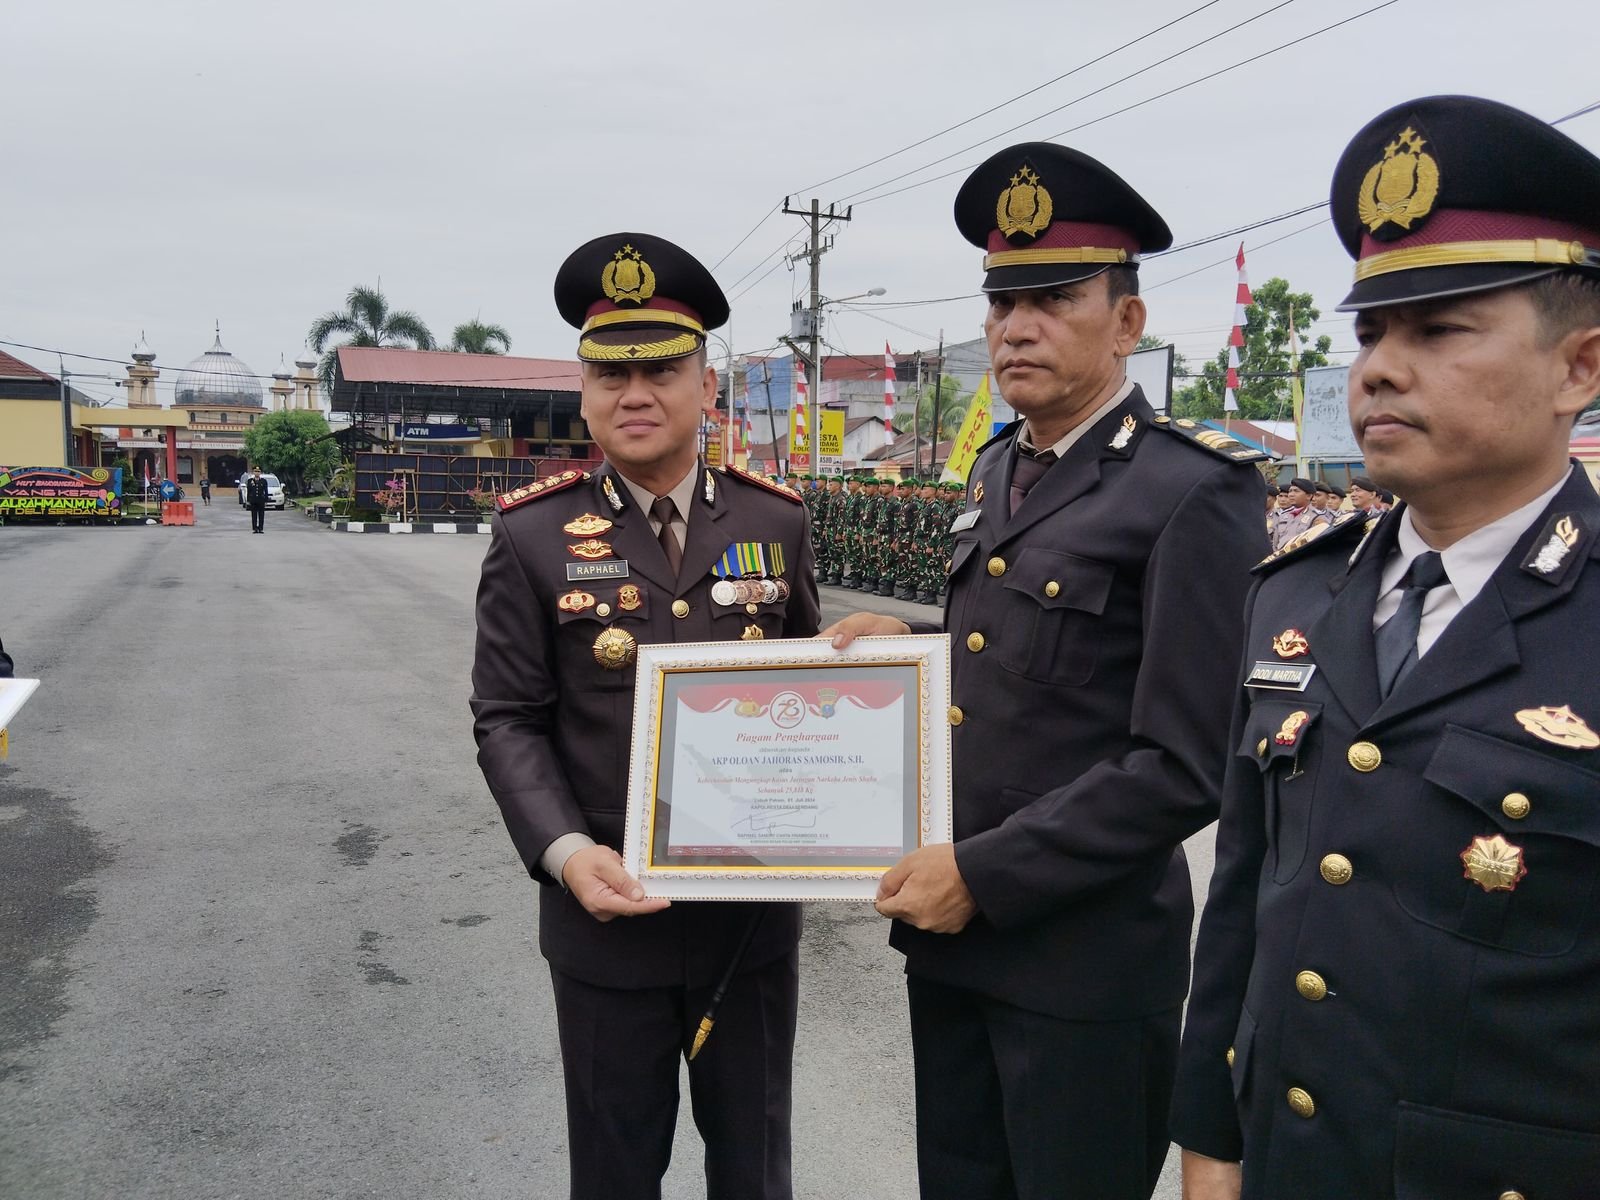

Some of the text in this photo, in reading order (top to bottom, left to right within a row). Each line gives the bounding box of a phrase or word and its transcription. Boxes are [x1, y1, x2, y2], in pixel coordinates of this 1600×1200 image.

[407, 427, 429, 435] ATM
[576, 564, 620, 575] RAPHAEL
[1253, 669, 1302, 681] DODI MARTHA
[736, 732, 839, 743] Piagam Penghargaan
[712, 756, 729, 765] AKP
[729, 756, 760, 765] OLOAN
[762, 755, 802, 765] JAHORAS
[803, 755, 846, 765] SAMOSIR,
